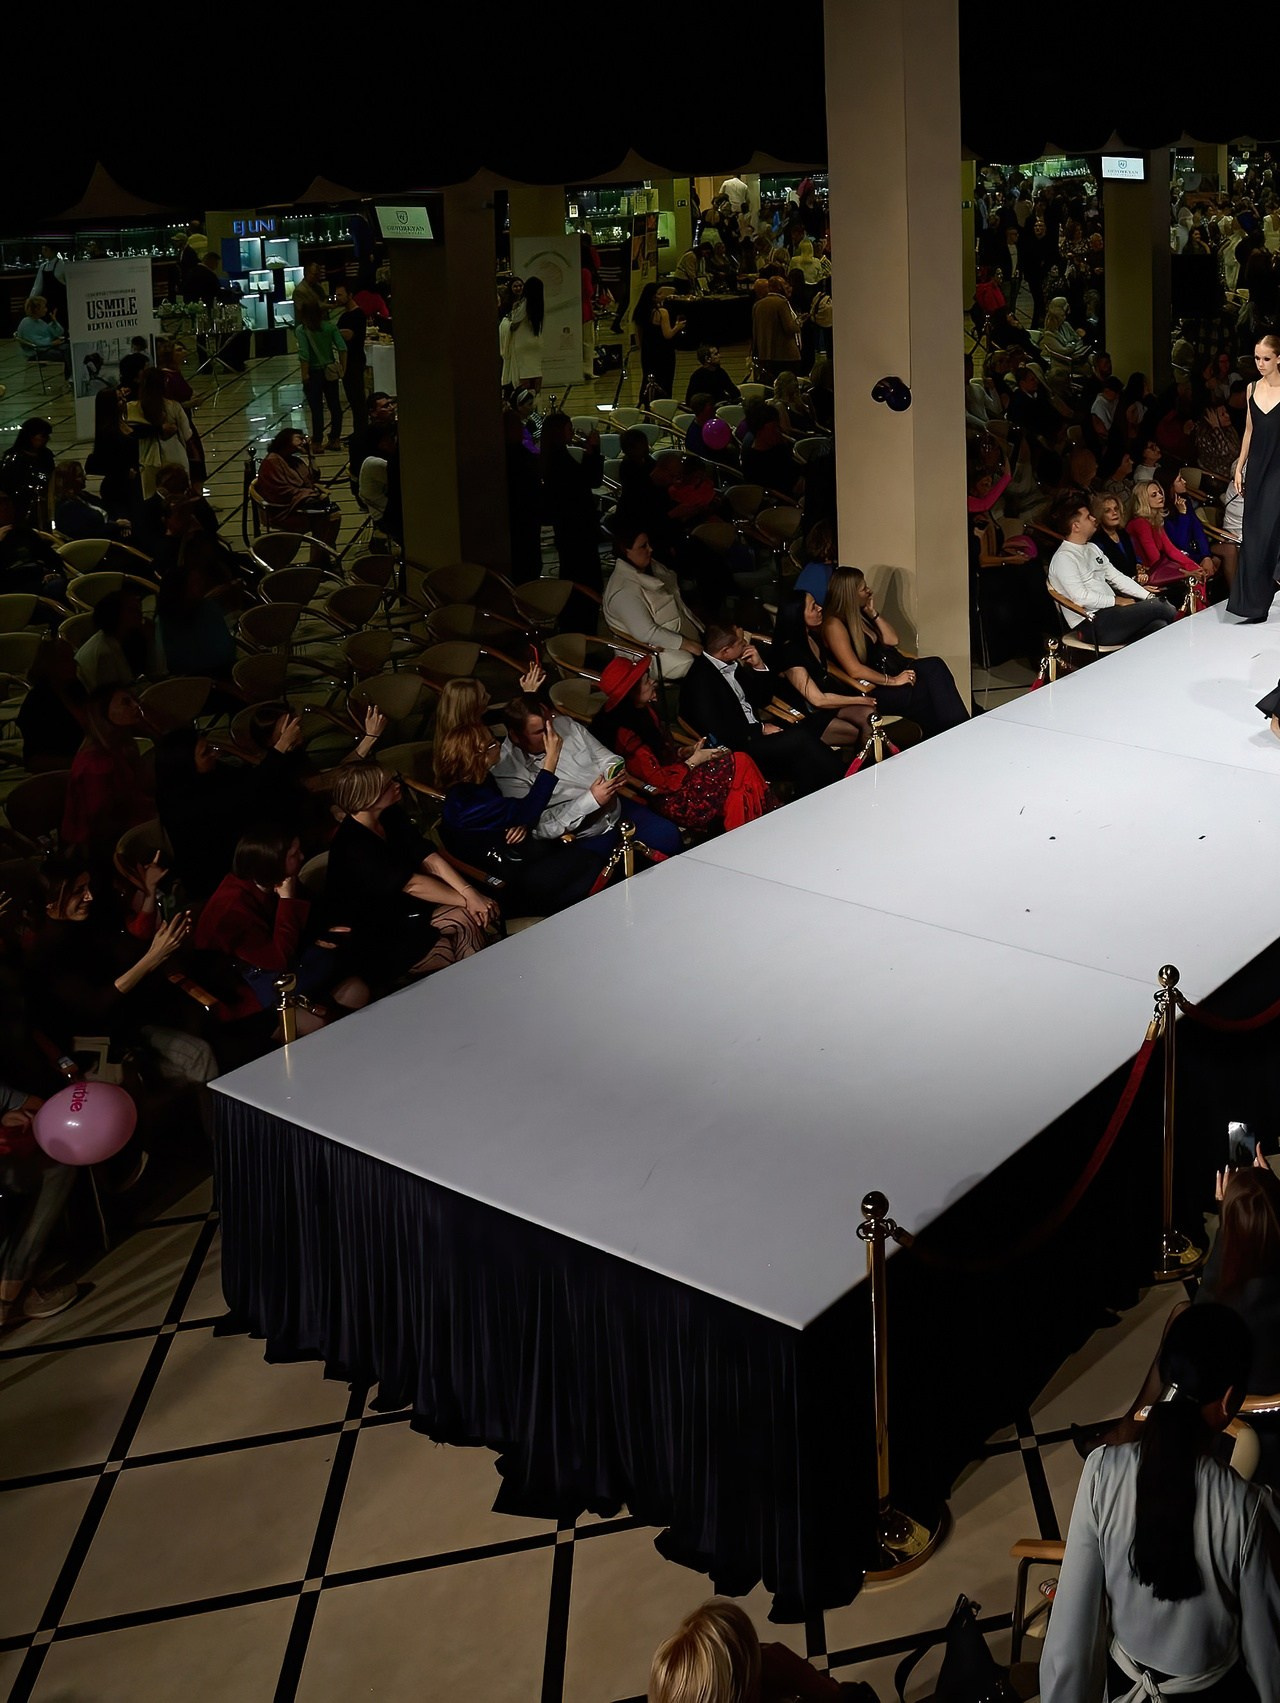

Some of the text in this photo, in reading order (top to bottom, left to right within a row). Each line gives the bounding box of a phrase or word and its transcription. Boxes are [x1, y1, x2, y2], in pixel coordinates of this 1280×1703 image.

[248, 218, 275, 233] UNI
[86, 296, 138, 320] USMILE
[87, 318, 138, 332] DENTAL CLINIC
